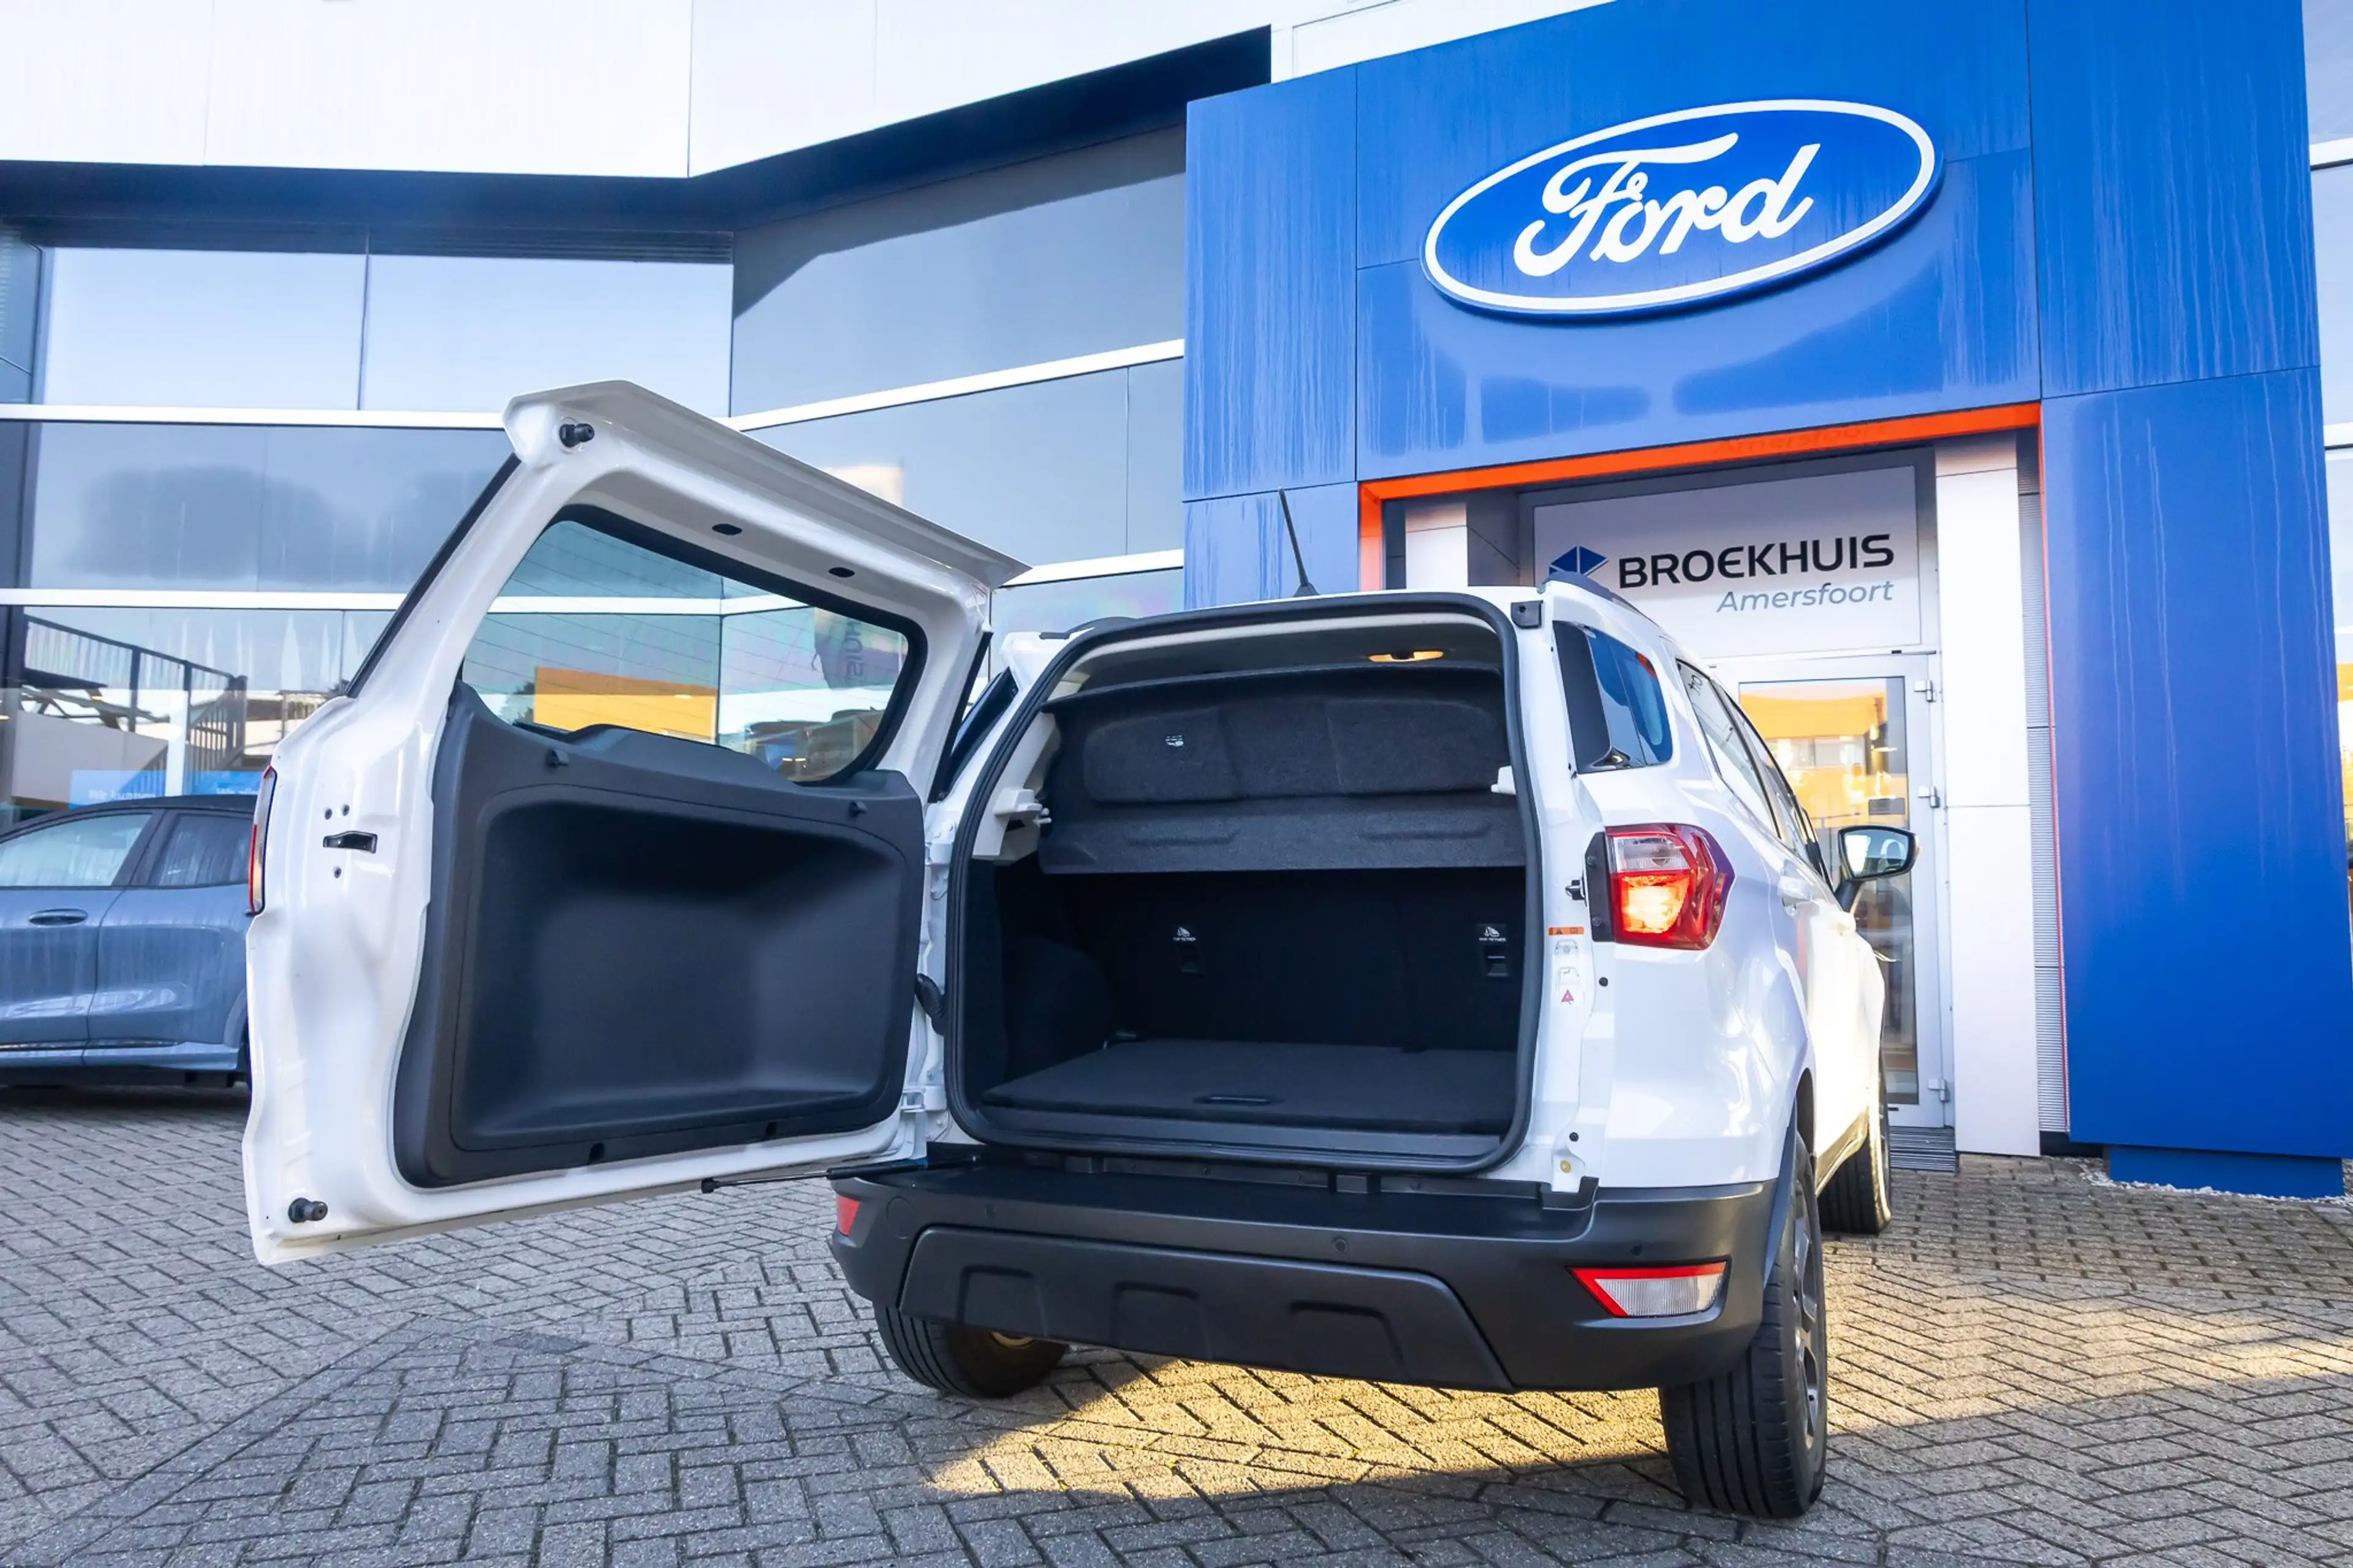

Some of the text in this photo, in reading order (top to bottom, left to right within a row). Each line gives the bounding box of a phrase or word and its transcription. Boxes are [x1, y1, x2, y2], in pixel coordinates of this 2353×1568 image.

[1513, 132, 1821, 277] Ford
[1619, 534, 1894, 589] BROEKHUIS
[1716, 581, 1893, 612] Amersfoort
